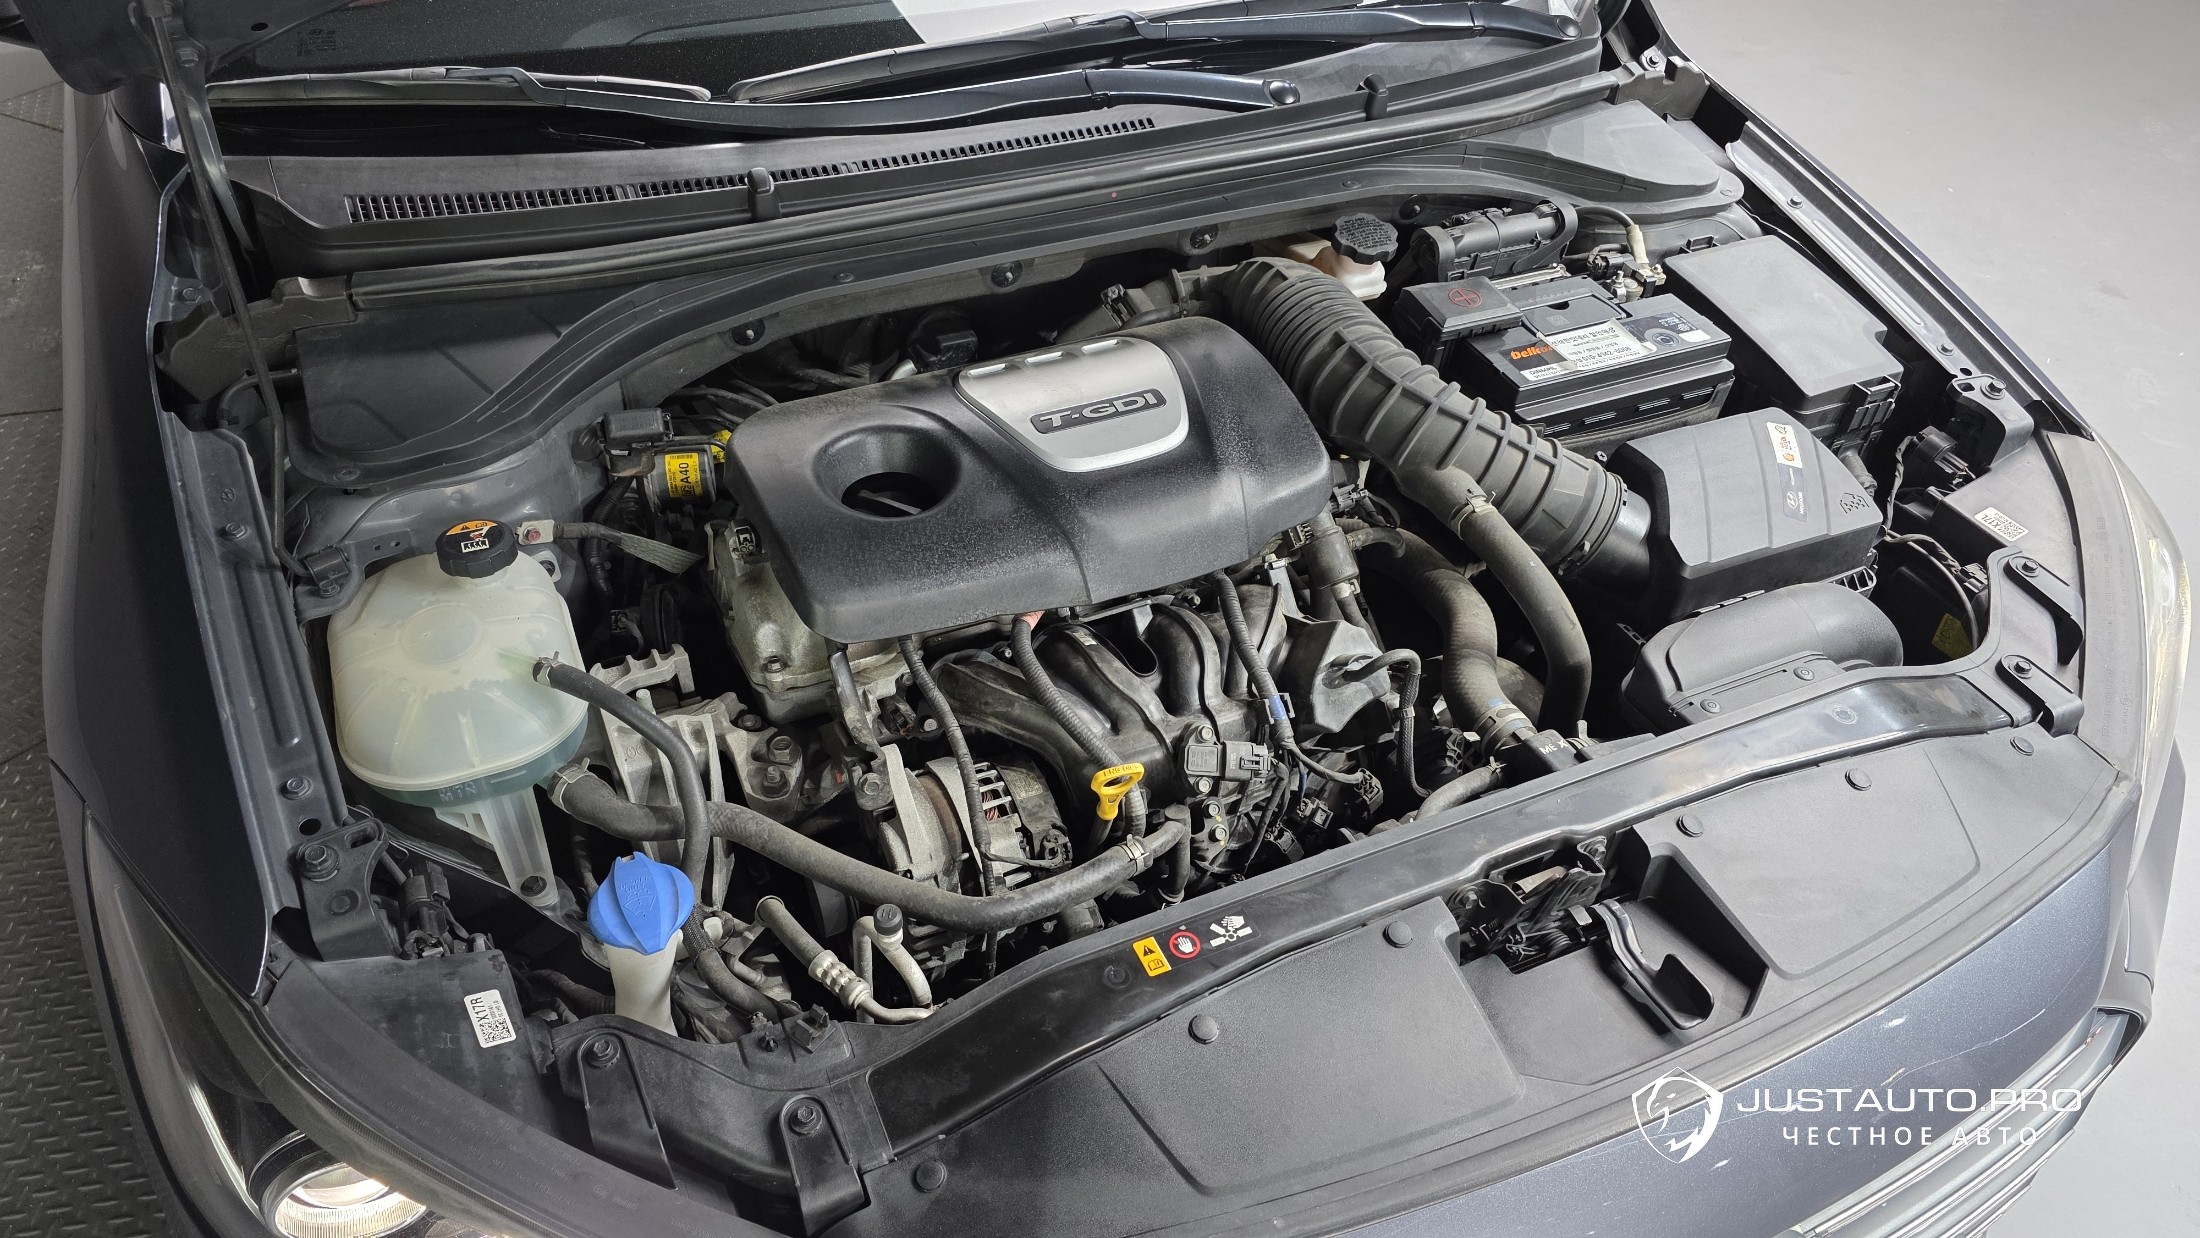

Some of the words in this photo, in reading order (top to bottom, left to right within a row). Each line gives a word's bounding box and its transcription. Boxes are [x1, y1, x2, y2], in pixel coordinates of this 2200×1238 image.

[1040, 392, 1158, 427] T-GDI
[678, 462, 691, 485] A40
[1980, 514, 2001, 529] X17L
[470, 997, 490, 1023] X17R
